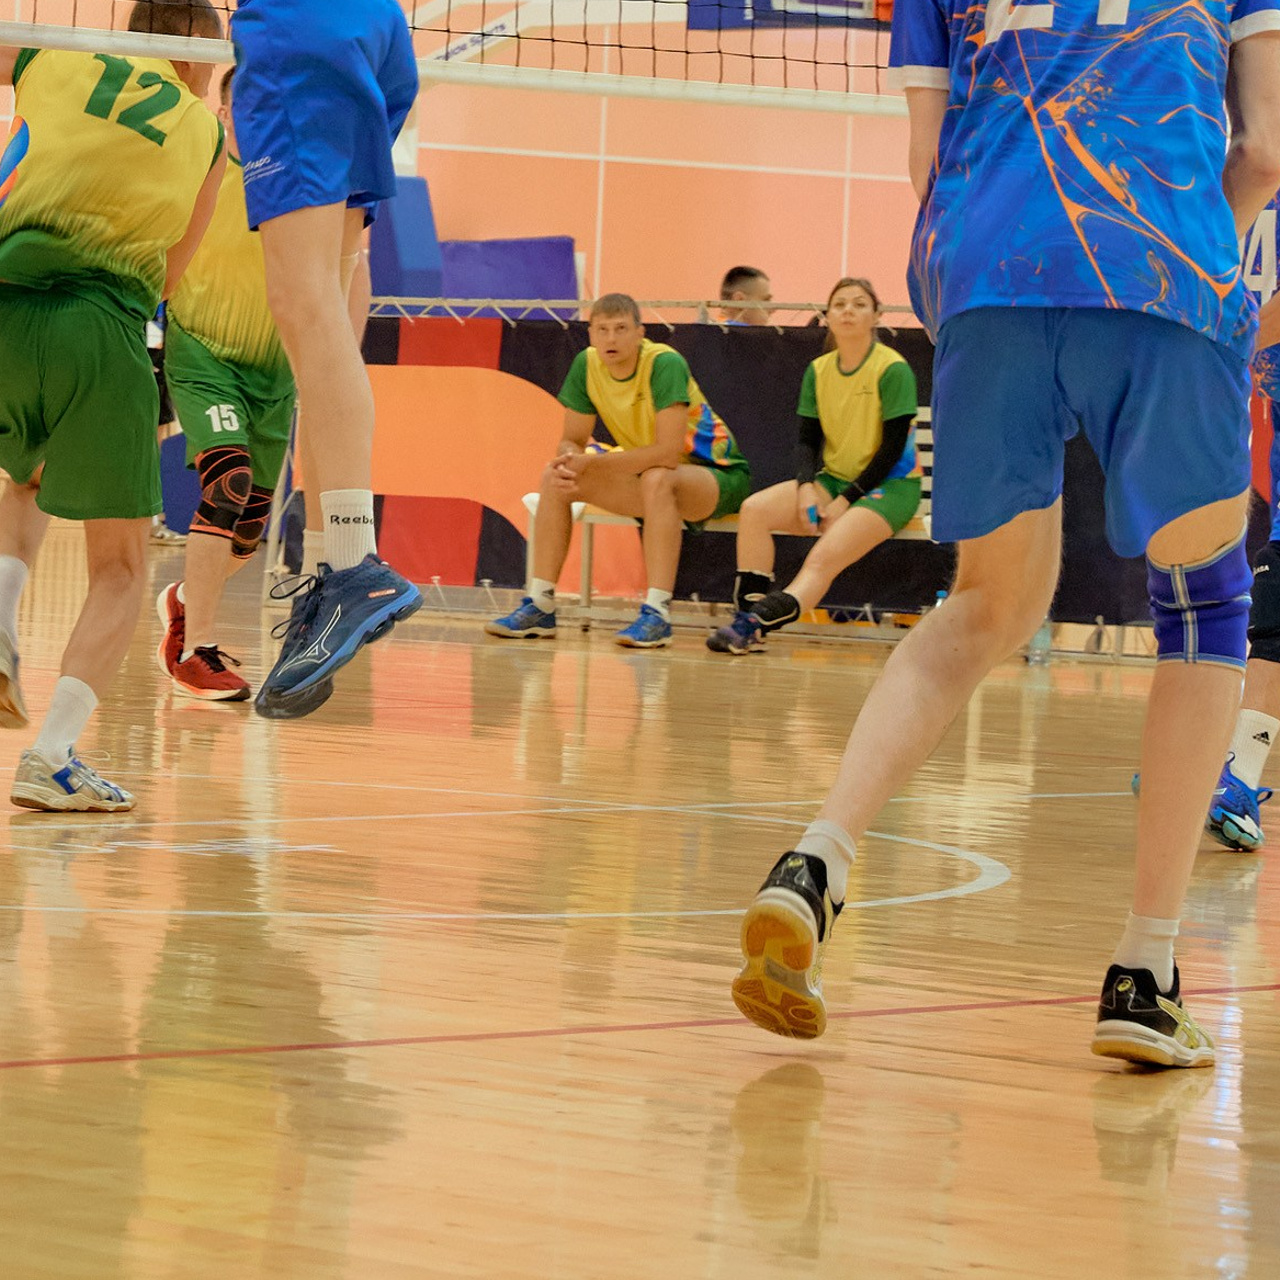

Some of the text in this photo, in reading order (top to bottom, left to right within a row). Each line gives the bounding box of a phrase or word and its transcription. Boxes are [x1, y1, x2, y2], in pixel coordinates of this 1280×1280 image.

[83, 52, 182, 148] 12
[1239, 209, 1278, 308] 4
[205, 404, 240, 433] 15
